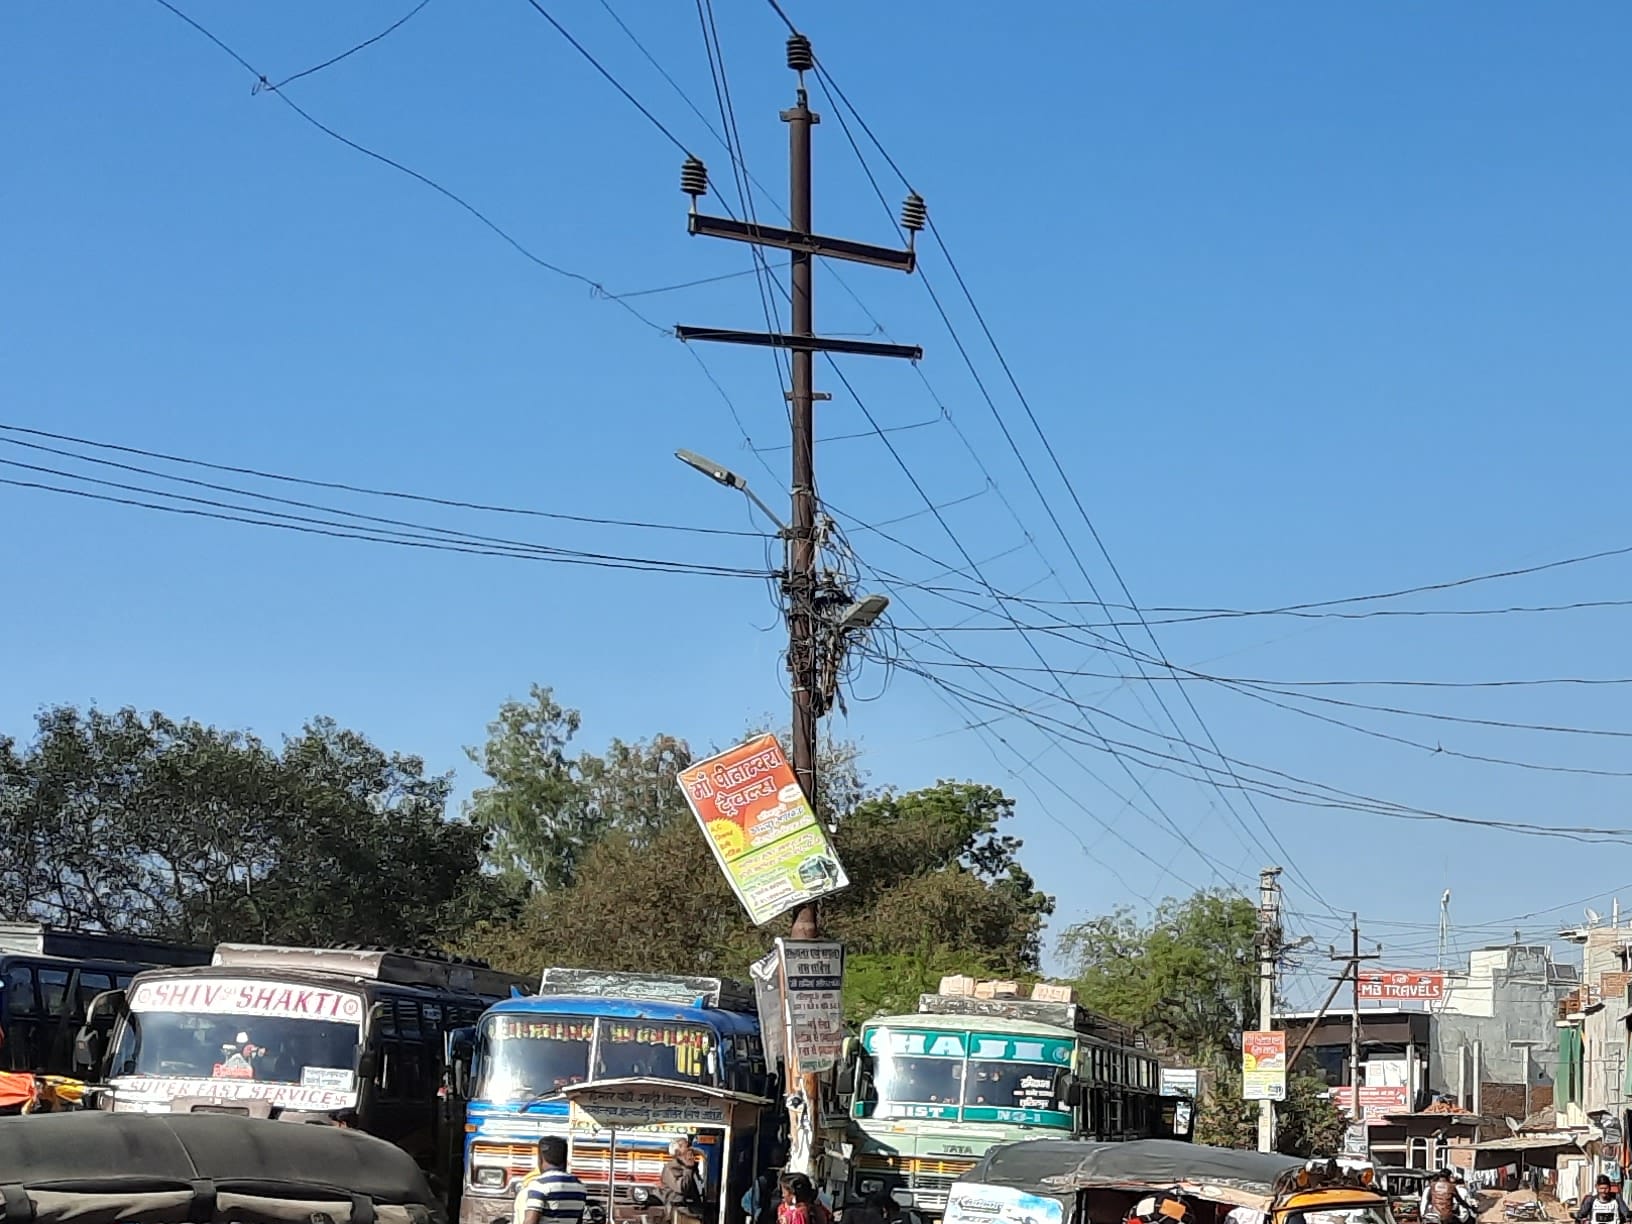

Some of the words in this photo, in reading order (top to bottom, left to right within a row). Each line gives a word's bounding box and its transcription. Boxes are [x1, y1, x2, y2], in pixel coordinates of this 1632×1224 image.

[1361, 984, 1382, 996] MB
[1384, 983, 1440, 997] TRAVELS
[152, 984, 222, 1008] SHIV
[236, 985, 344, 1017] SHAKTI
[130, 1079, 190, 1097] SUPER
[196, 1081, 240, 1099] FAST
[251, 1084, 333, 1105] SERVICE
[942, 1144, 974, 1154] TATA
